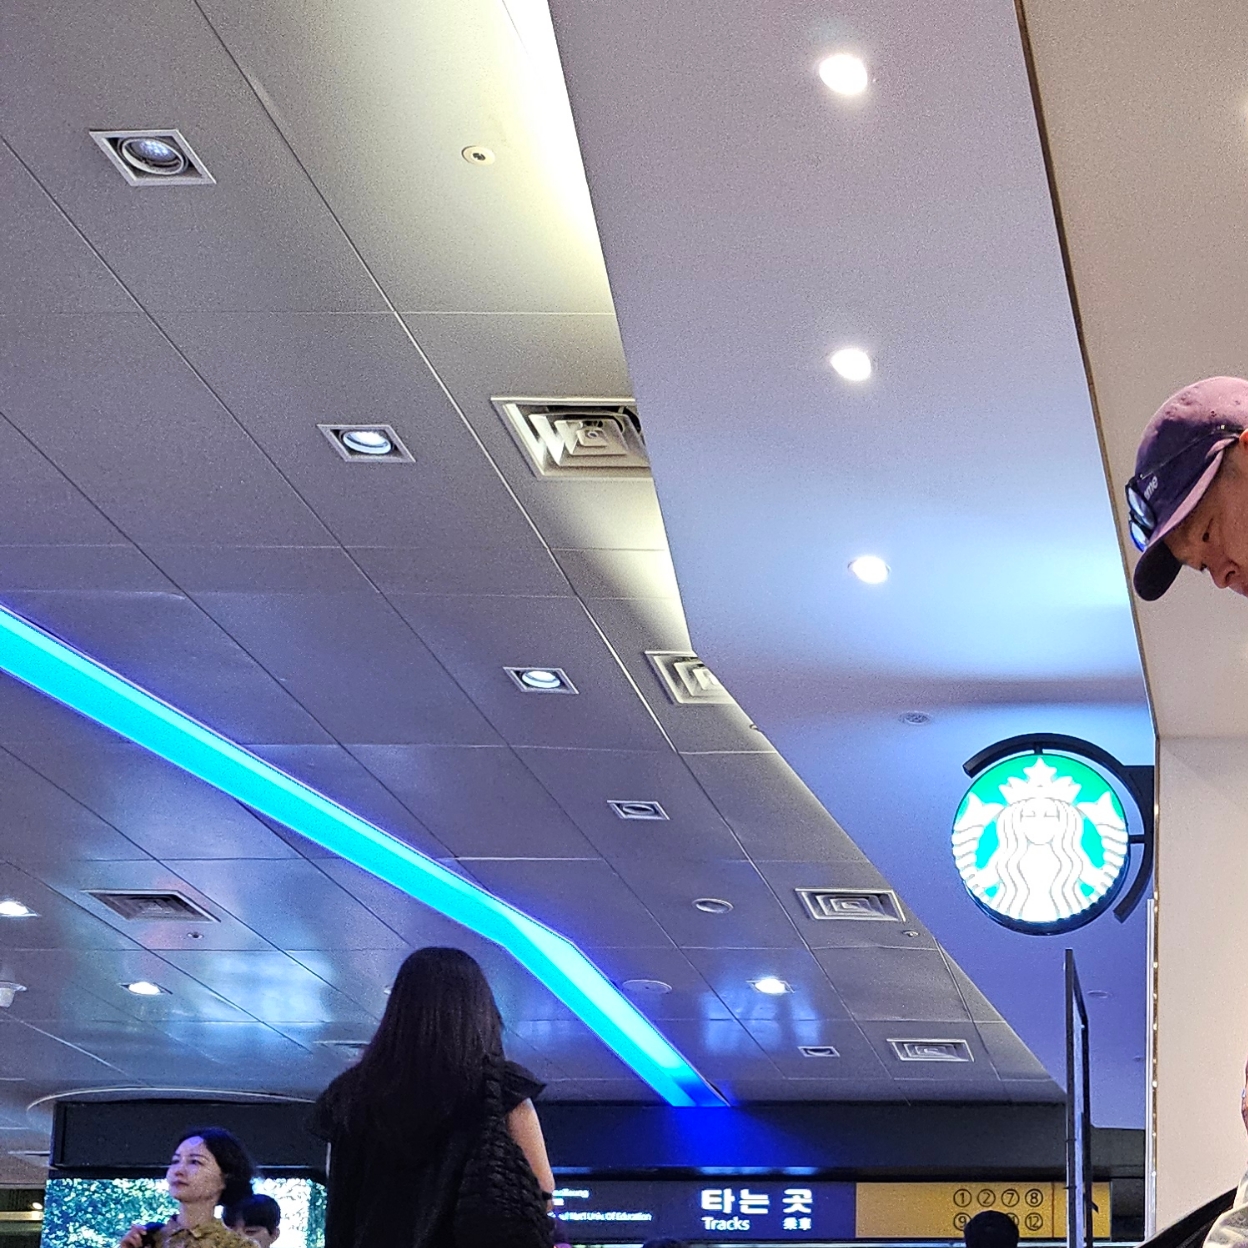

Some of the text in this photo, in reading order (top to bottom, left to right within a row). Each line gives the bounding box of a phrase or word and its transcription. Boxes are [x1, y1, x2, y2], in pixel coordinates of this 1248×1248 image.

[701, 1187, 813, 1214] 타는 곳
[701, 1216, 750, 1231] Tracks
